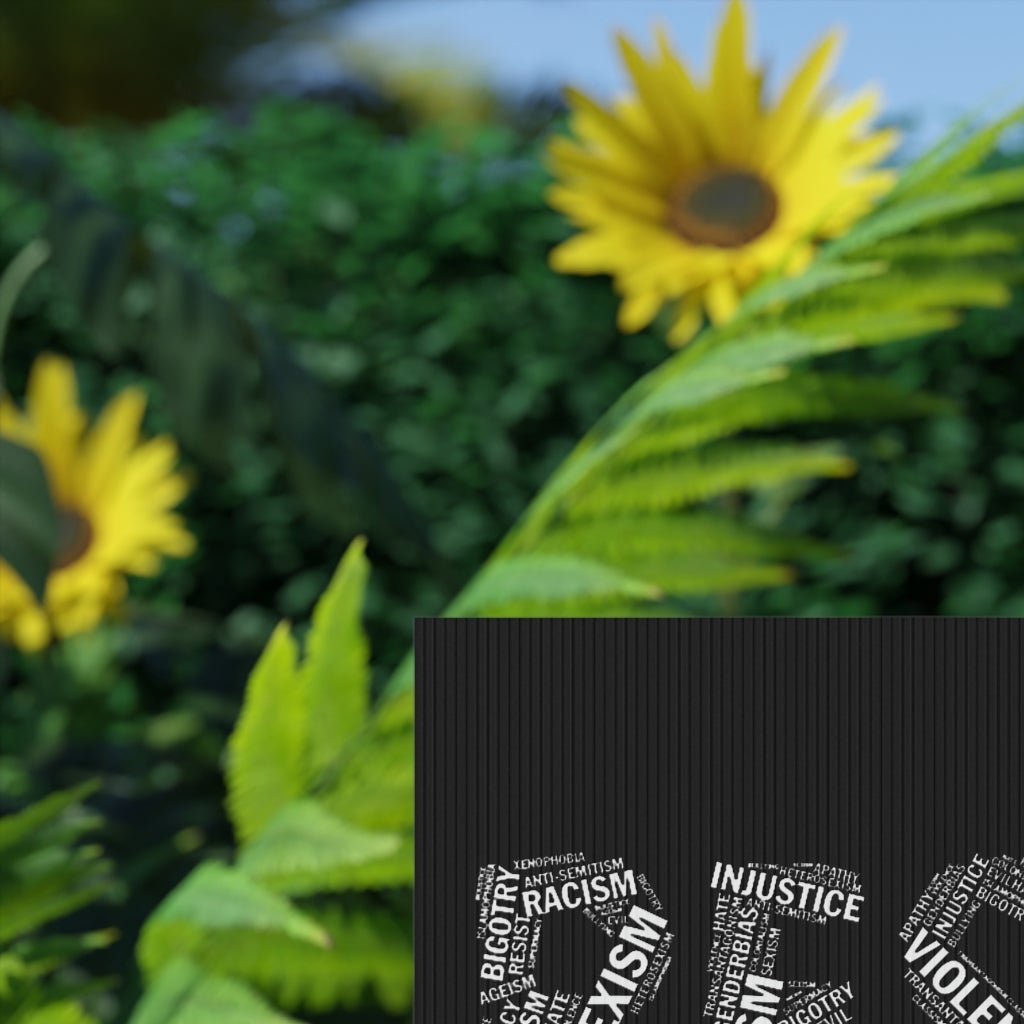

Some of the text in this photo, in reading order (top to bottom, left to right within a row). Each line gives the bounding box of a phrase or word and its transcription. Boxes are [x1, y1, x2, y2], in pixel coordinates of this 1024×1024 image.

[514, 852, 586, 870] XENOPHOBIA
[525, 857, 625, 889] ANTI-SEMITISM
[814, 863, 861, 890] APATHY
[987, 865, 1012, 887] EVIL
[522, 869, 638, 918] RACISM
[637, 873, 664, 912] BIGOTRY
[711, 861, 865, 923] INJUSTICE
[713, 892, 731, 932] HATE
[899, 890, 934, 943] APATHY
[923, 864, 966, 927] GENDERBIAS
[932, 853, 990, 940] INJUSTICE
[481, 865, 520, 982] BIGOTRY
[509, 913, 531, 975] RESIST
[947, 899, 981, 948] BULLYING
[630, 931, 676, 1016] HETEROSEXISM
[761, 927, 782, 977] SEXISM
[481, 974, 537, 1005] AGEISM
